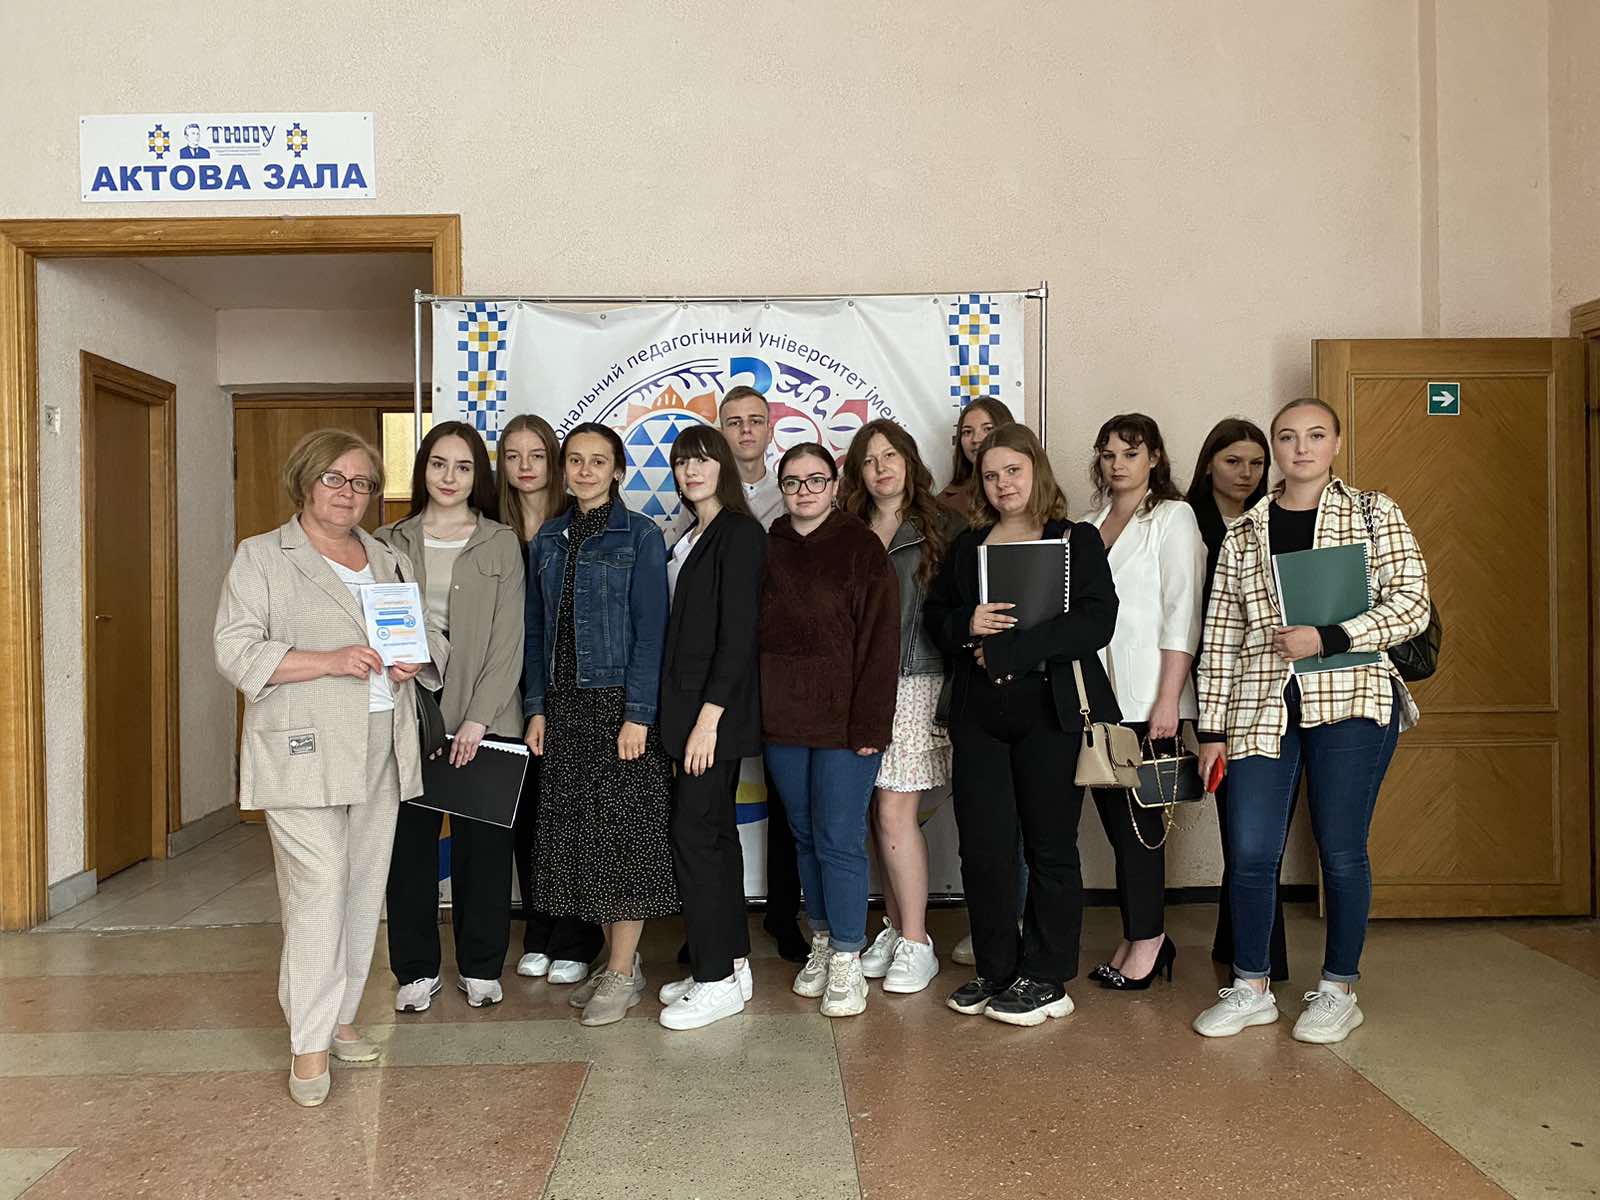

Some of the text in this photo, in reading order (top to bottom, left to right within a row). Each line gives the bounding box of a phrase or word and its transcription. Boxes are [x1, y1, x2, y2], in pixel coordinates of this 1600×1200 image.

[91, 163, 368, 192] АКТОВА ЗАЛА
[555, 327, 907, 440] ональний педагогічний університет іме
